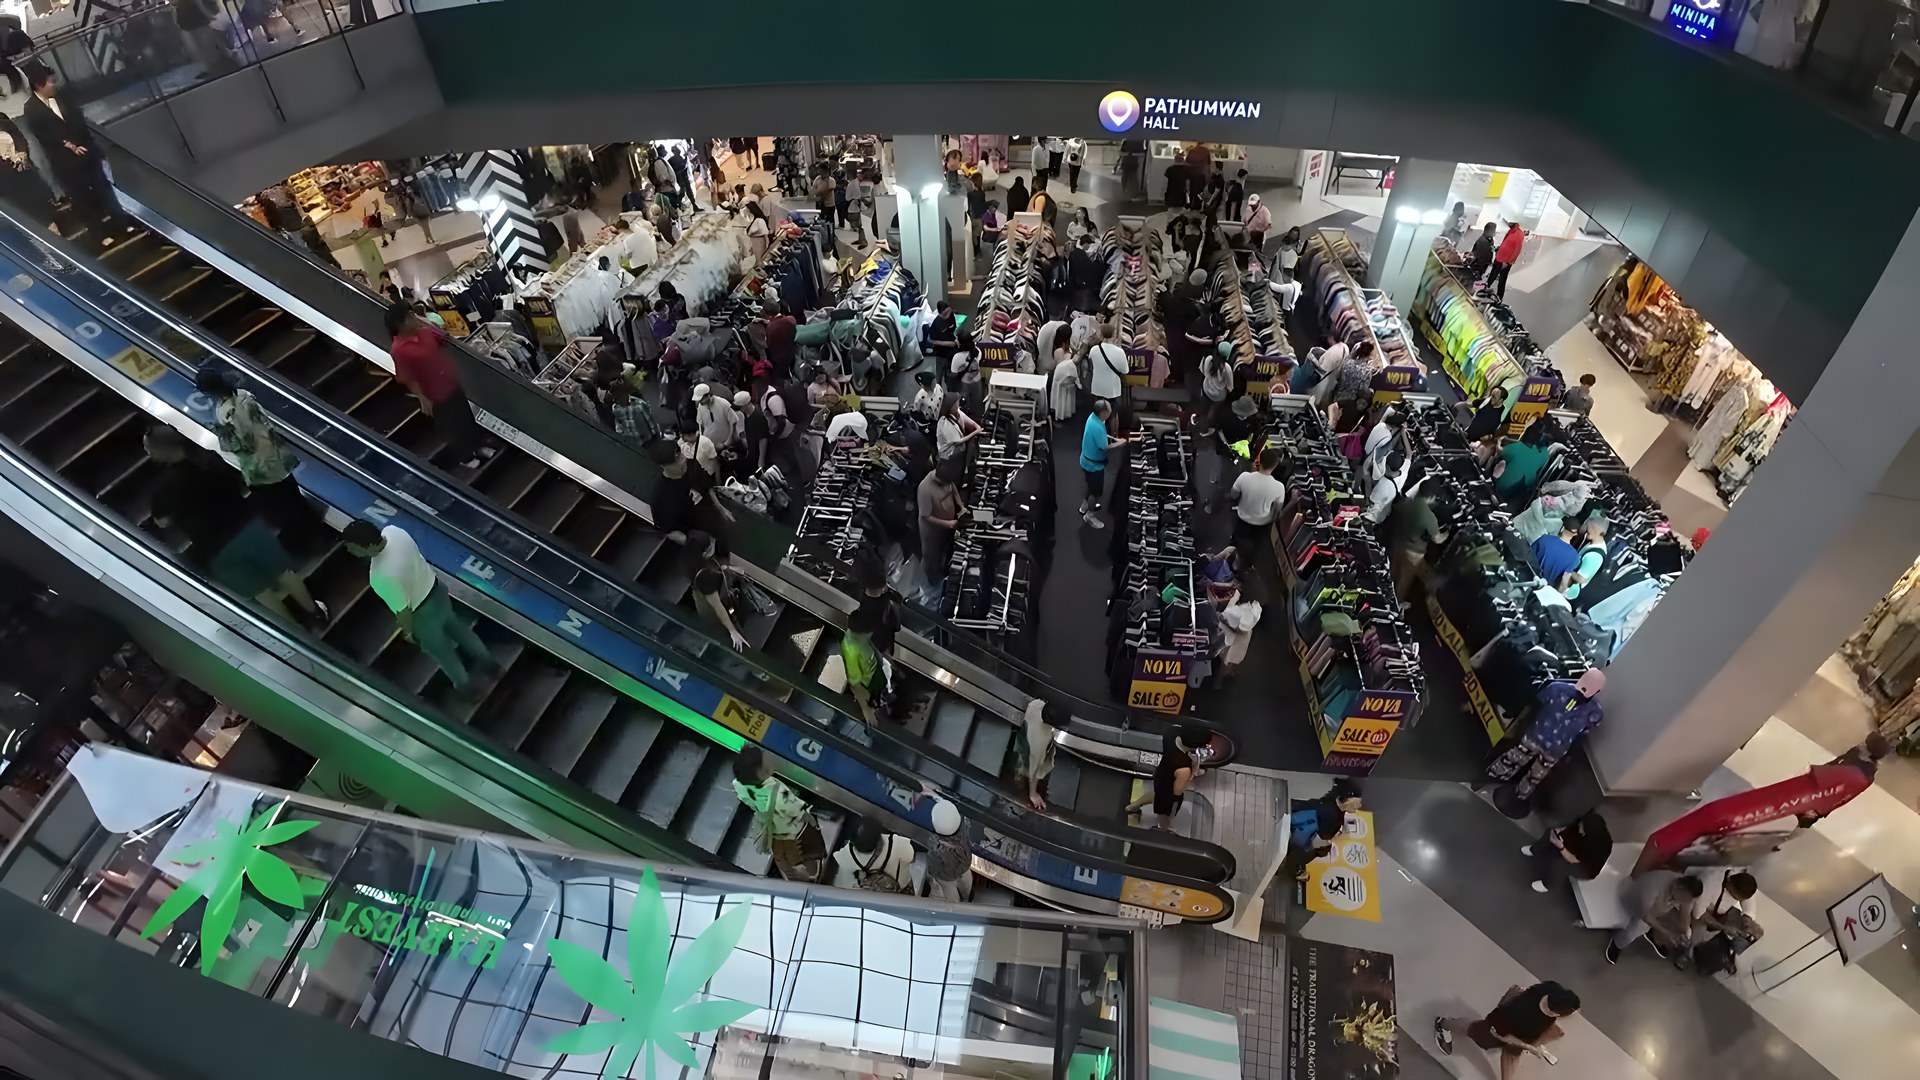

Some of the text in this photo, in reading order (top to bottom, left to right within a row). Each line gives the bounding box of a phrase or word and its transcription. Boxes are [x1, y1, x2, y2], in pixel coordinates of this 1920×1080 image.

[1671, 3, 1716, 30] MINIMA
[1144, 97, 1261, 119] PATHUMWAN
[1143, 115, 1180, 130] HALL
[1142, 659, 1182, 675] NOVA
[1131, 691, 1162, 706] SALE
[1360, 697, 1402, 713] NOVA
[1340, 727, 1372, 743] SALE
[1733, 806, 1775, 823] SALE
[1779, 784, 1845, 811] AVENUE
[1308, 968, 1318, 1038] TRADITIONAL
